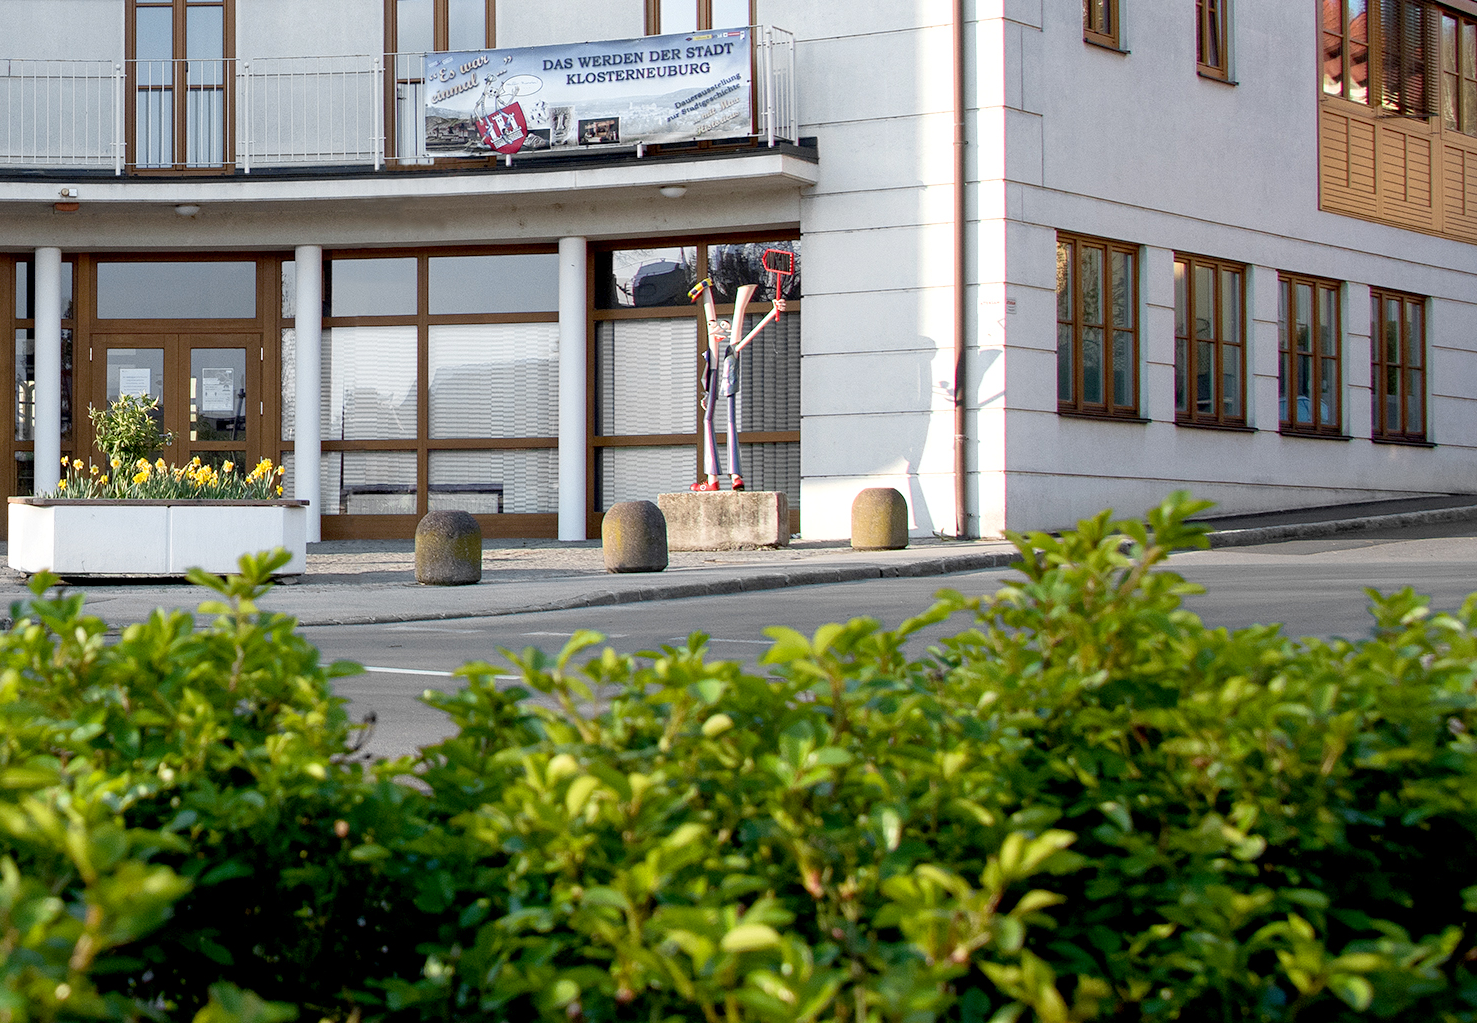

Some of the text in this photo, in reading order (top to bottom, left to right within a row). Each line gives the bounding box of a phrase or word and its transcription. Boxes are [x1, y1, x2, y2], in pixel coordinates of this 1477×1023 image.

[460, 55, 490, 75] war
[542, 42, 735, 71] DAS WERDEN DER STADT
[431, 73, 479, 104] einmal
[566, 62, 711, 85] KLOSTERNEUBURG
[666, 83, 741, 123] zur Stadtgeschichte
[674, 72, 742, 109] Dauerausstellung
